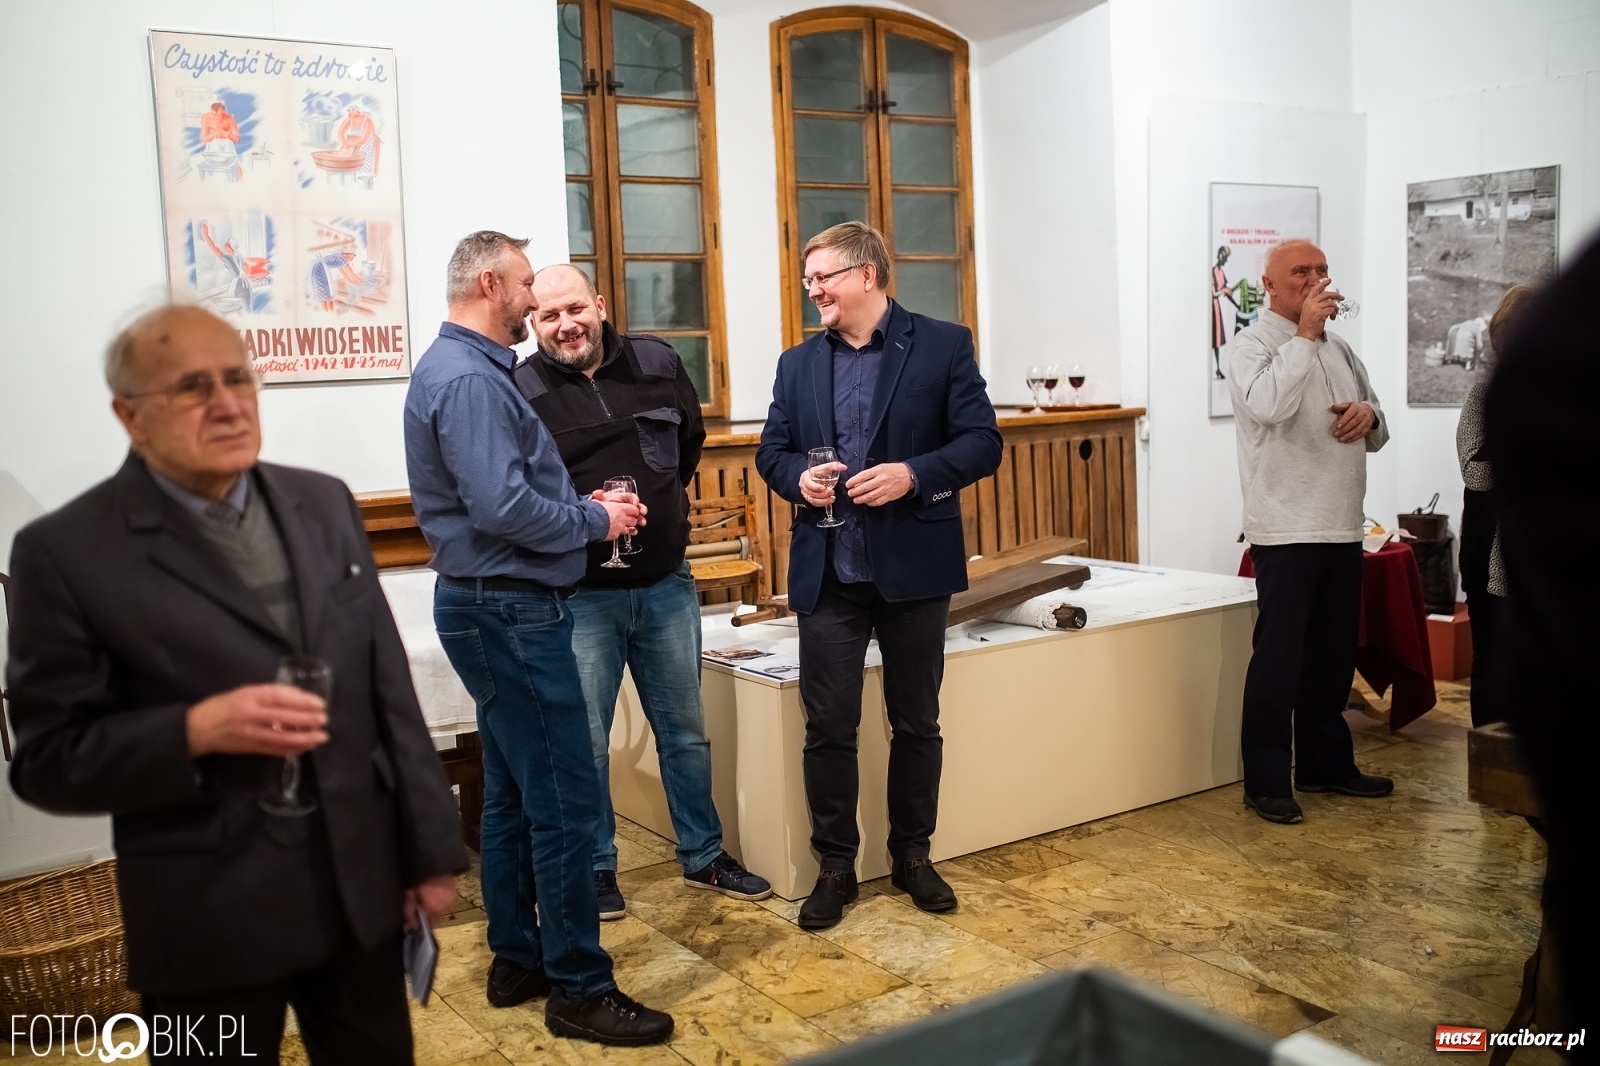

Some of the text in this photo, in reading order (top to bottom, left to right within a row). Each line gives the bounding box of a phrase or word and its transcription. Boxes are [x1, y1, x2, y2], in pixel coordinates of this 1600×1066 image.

[164, 43, 388, 83] Czystość to zdroie
[295, 325, 404, 356] WIOSENNE
[377, 354, 404, 370] maj
